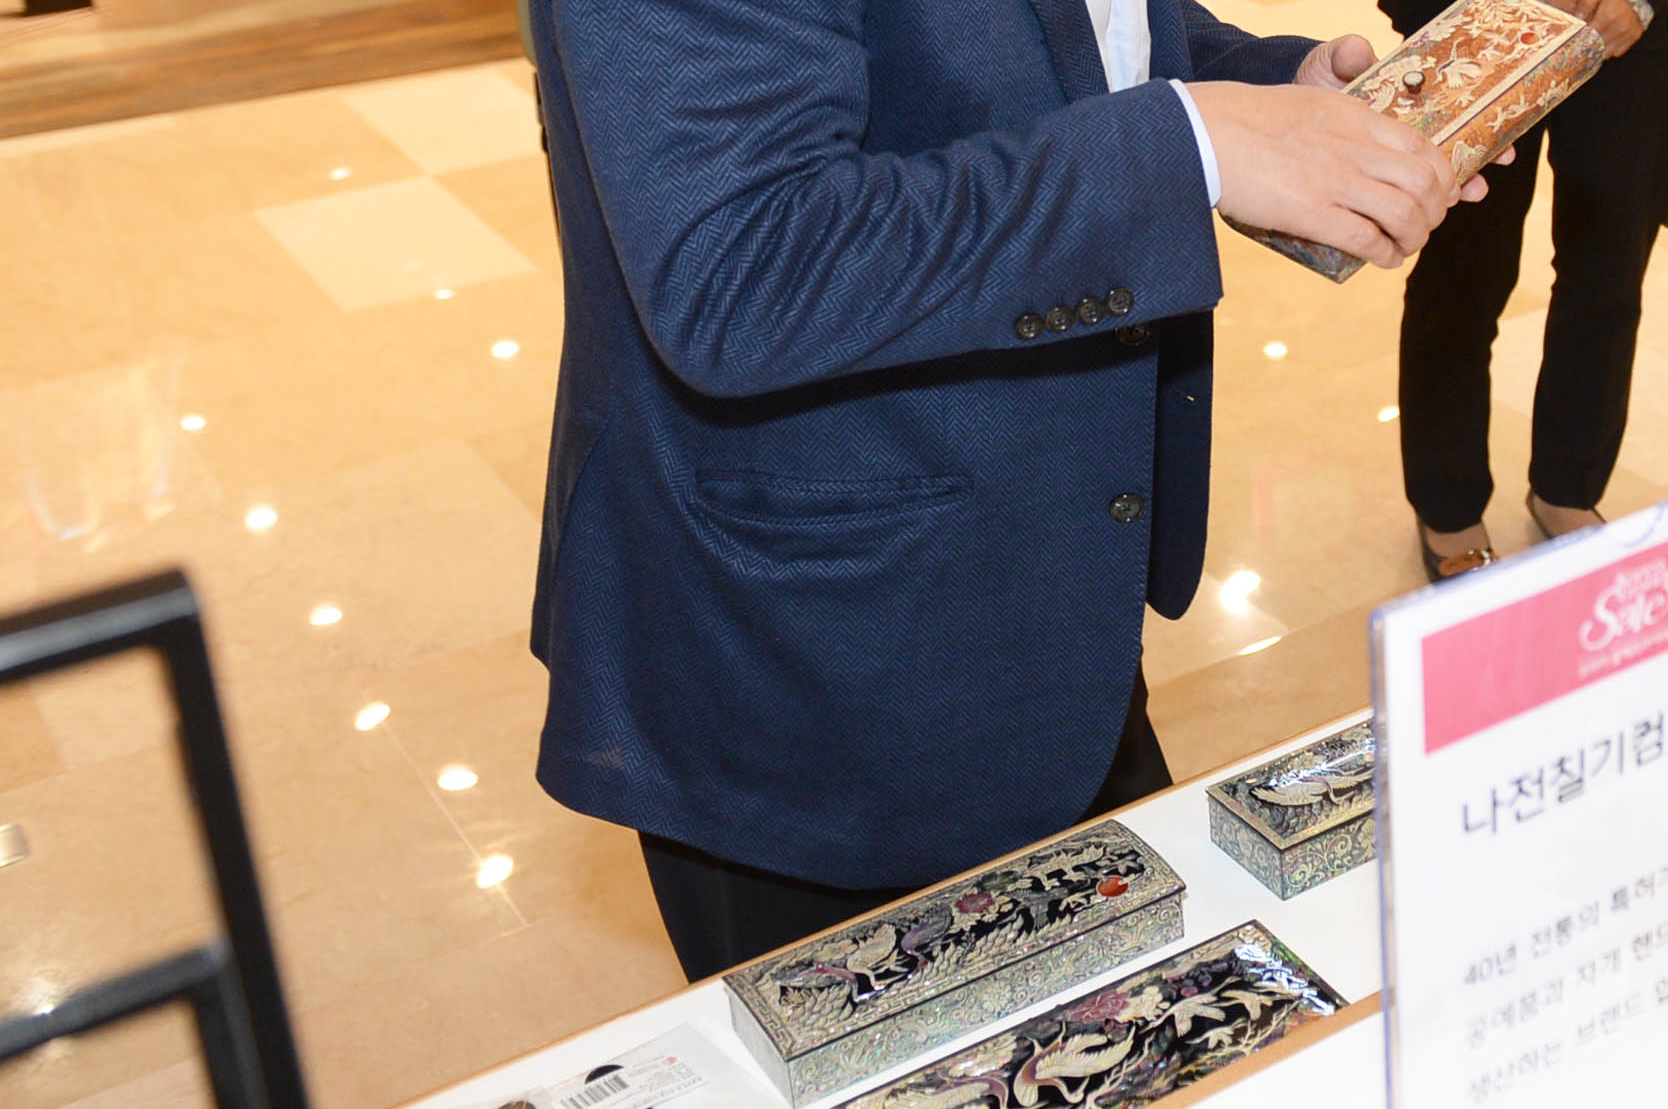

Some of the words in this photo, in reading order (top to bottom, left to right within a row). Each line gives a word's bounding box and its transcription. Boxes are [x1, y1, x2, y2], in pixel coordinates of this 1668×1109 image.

[1463, 942, 1518, 987] 40년
[1529, 901, 1600, 959] 전통의
[1575, 993, 1645, 1049] 브랜드
